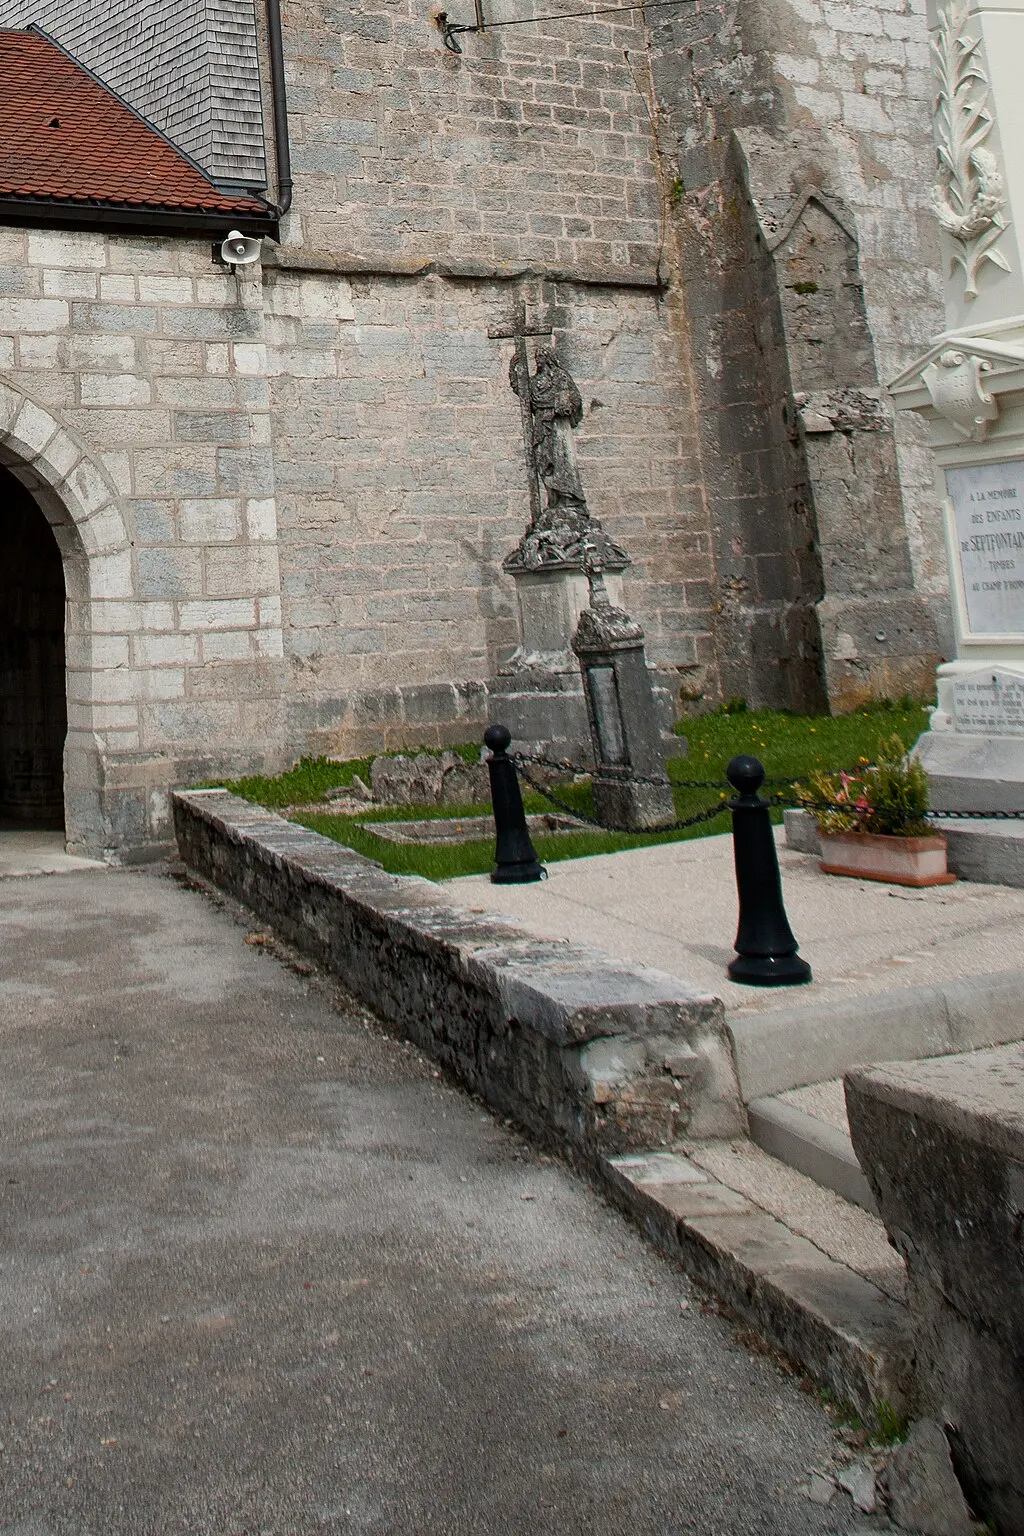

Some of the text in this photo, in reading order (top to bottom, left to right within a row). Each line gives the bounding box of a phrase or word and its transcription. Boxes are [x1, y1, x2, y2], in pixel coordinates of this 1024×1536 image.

[977, 492, 986, 501] LA
[971, 509, 1022, 524] DES ENFANTS
[961, 541, 969, 552] DE
[982, 581, 1002, 591] CHAMP
